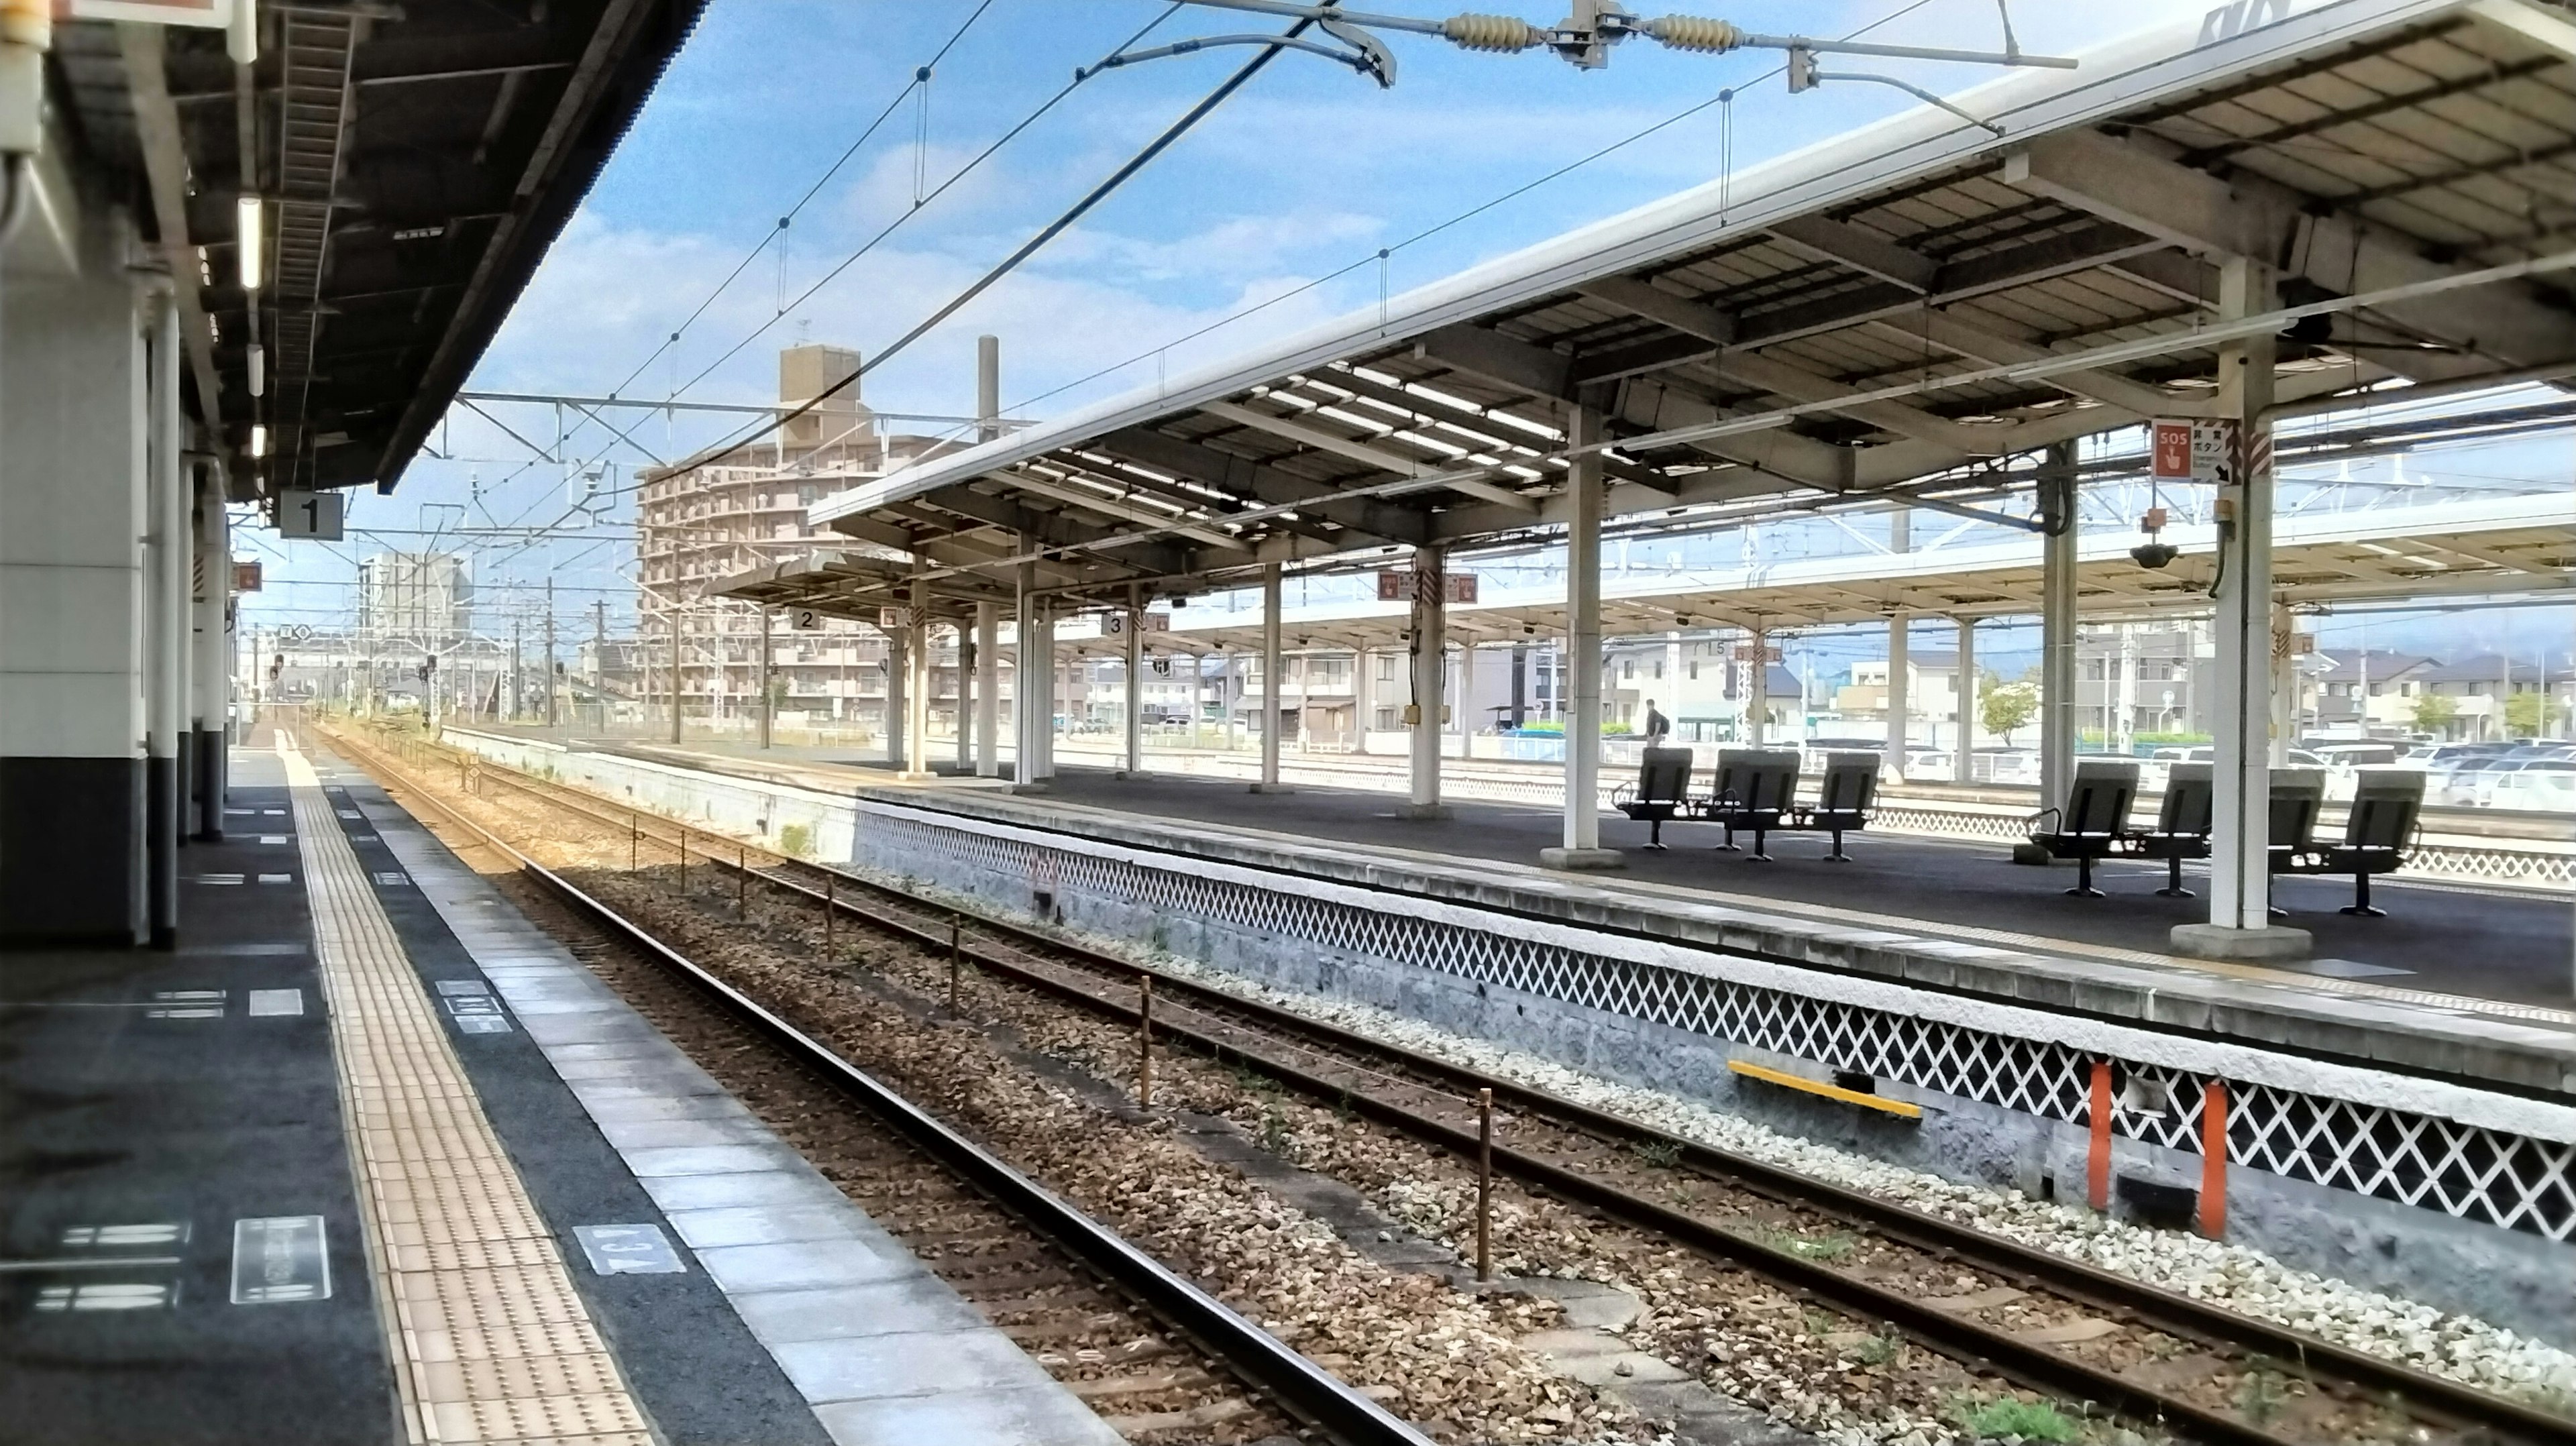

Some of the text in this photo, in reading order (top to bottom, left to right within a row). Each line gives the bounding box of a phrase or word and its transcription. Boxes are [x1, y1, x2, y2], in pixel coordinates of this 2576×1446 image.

[2160, 432, 2188, 445] SOS
[301, 498, 318, 533] 1
[802, 612, 813, 627] 2
[1111, 618, 1121, 633] 3
[1717, 641, 1725, 655] 5
